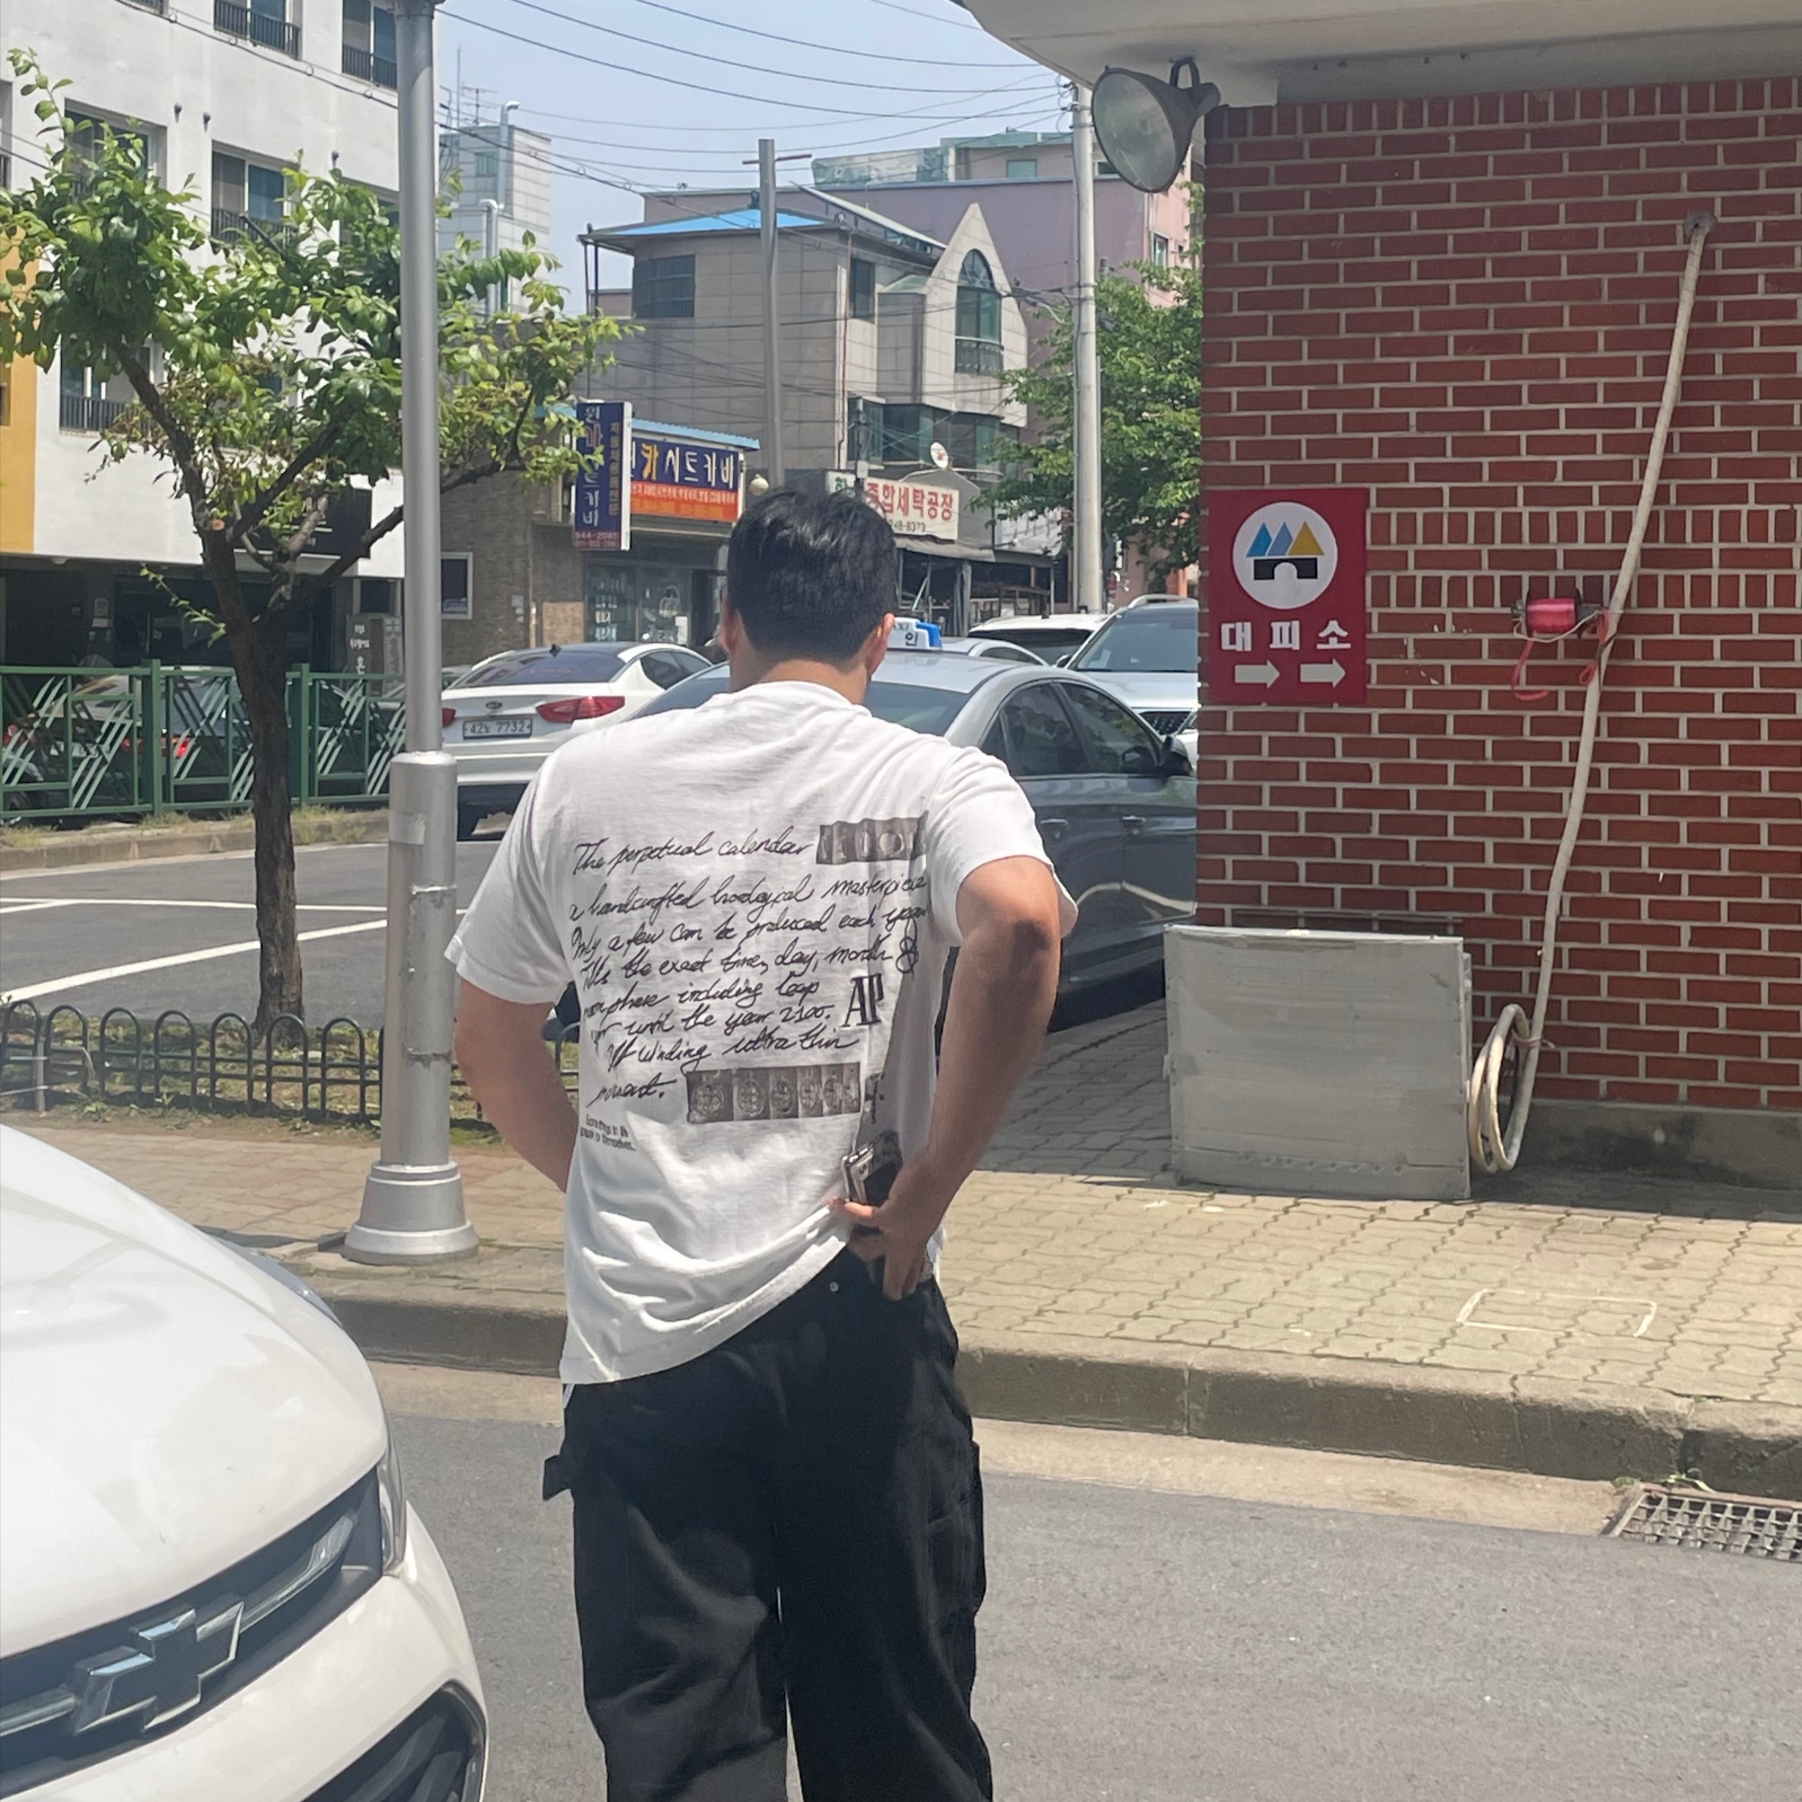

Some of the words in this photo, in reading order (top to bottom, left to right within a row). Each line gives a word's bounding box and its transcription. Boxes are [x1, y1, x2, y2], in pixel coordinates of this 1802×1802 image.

[905, 632, 918, 647] 인
[1221, 620, 1351, 651] 대피소
[573, 837, 609, 875] The
[607, 830, 715, 877] perpetual
[717, 825, 814, 856] calendar
[608, 935, 626, 951] a
[622, 922, 665, 958] few
[669, 923, 703, 942] can
[713, 912, 738, 941] be
[838, 904, 877, 929] each
[621, 946, 653, 979] the
[658, 948, 714, 976] exact
[824, 933, 894, 965] month
[681, 1003, 717, 1031] the
[724, 1010, 775, 1036] year
[799, 1022, 860, 1050] thin
